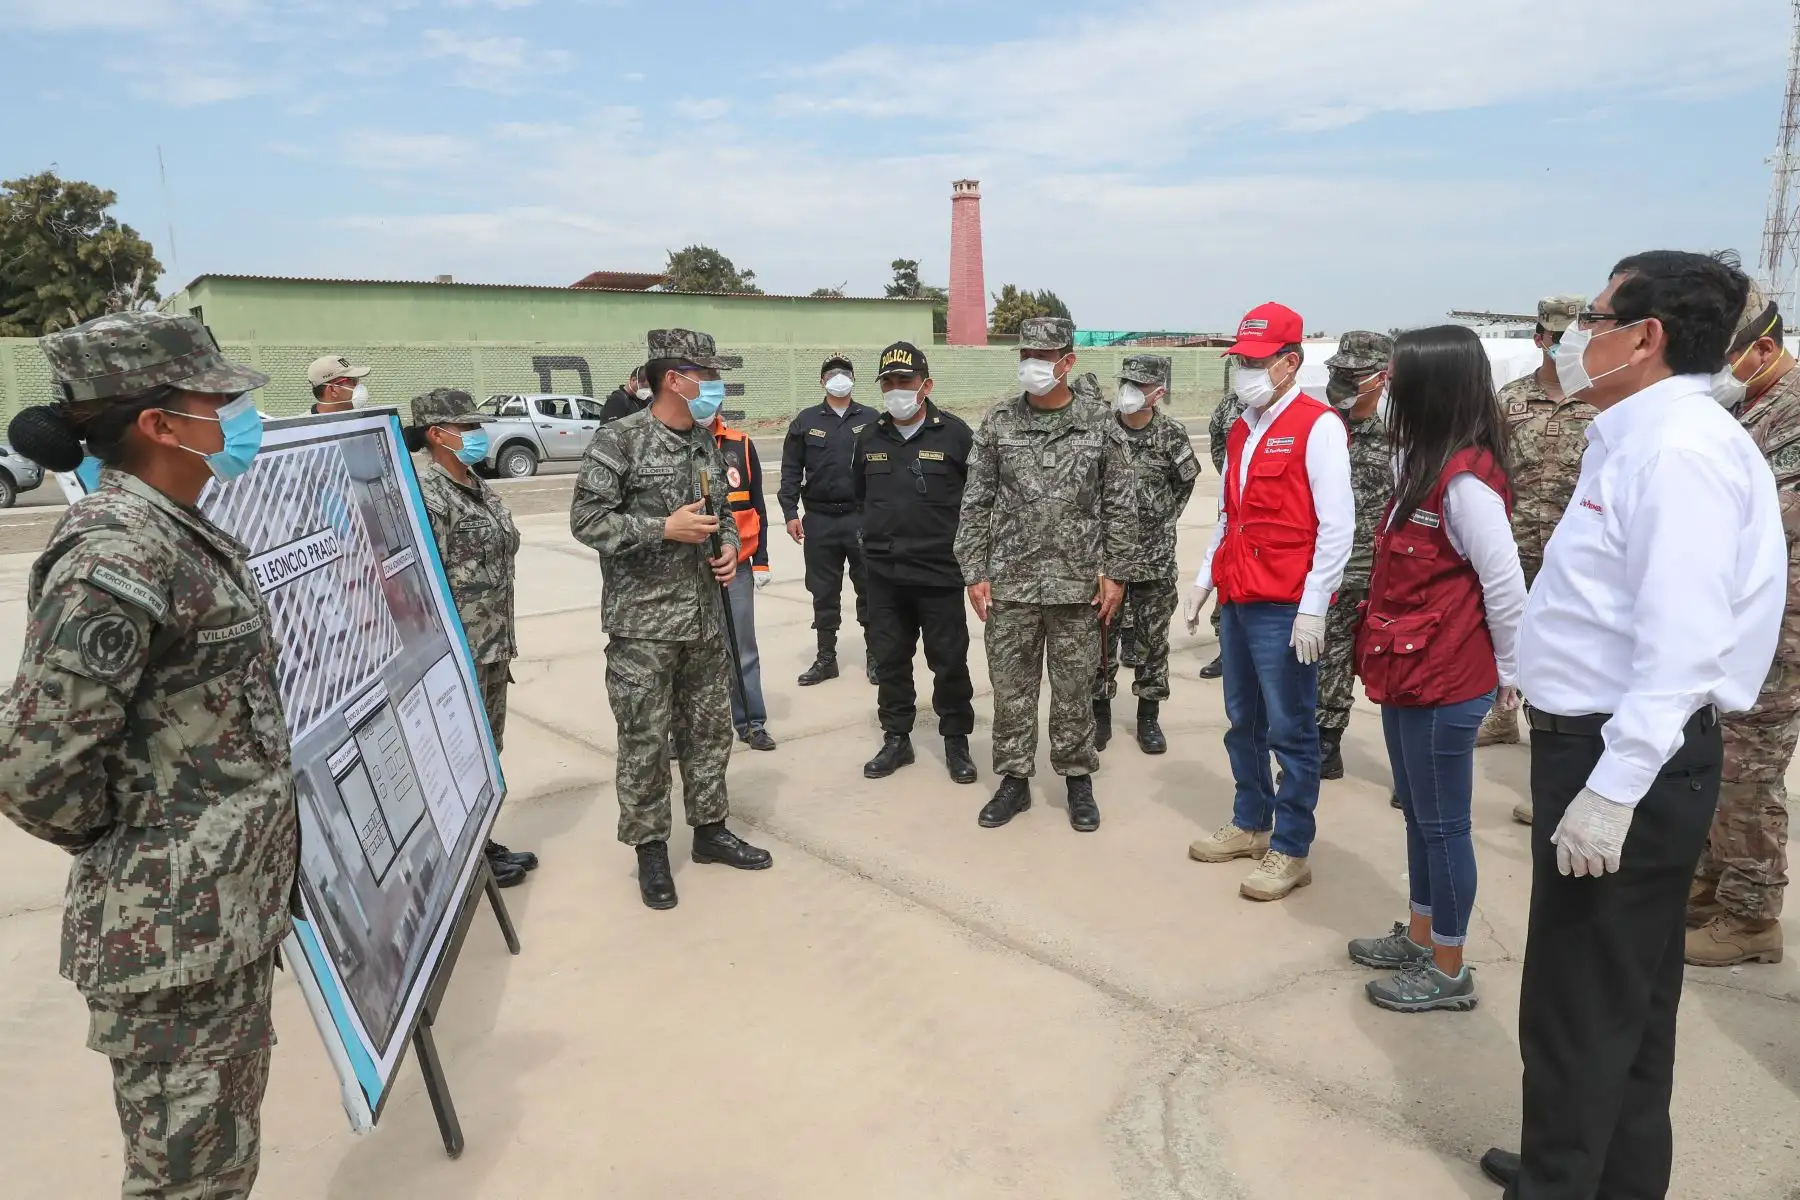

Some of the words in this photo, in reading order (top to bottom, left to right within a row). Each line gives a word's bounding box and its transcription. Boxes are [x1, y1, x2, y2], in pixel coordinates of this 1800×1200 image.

[882, 349, 912, 369] POLICIA
[264, 550, 308, 583] LEONCIO
[307, 535, 338, 563] PRADO
[95, 568, 133, 591] EJERCITO
[133, 586, 148, 597] DEL
[202, 616, 261, 641] VILLALOBOS
